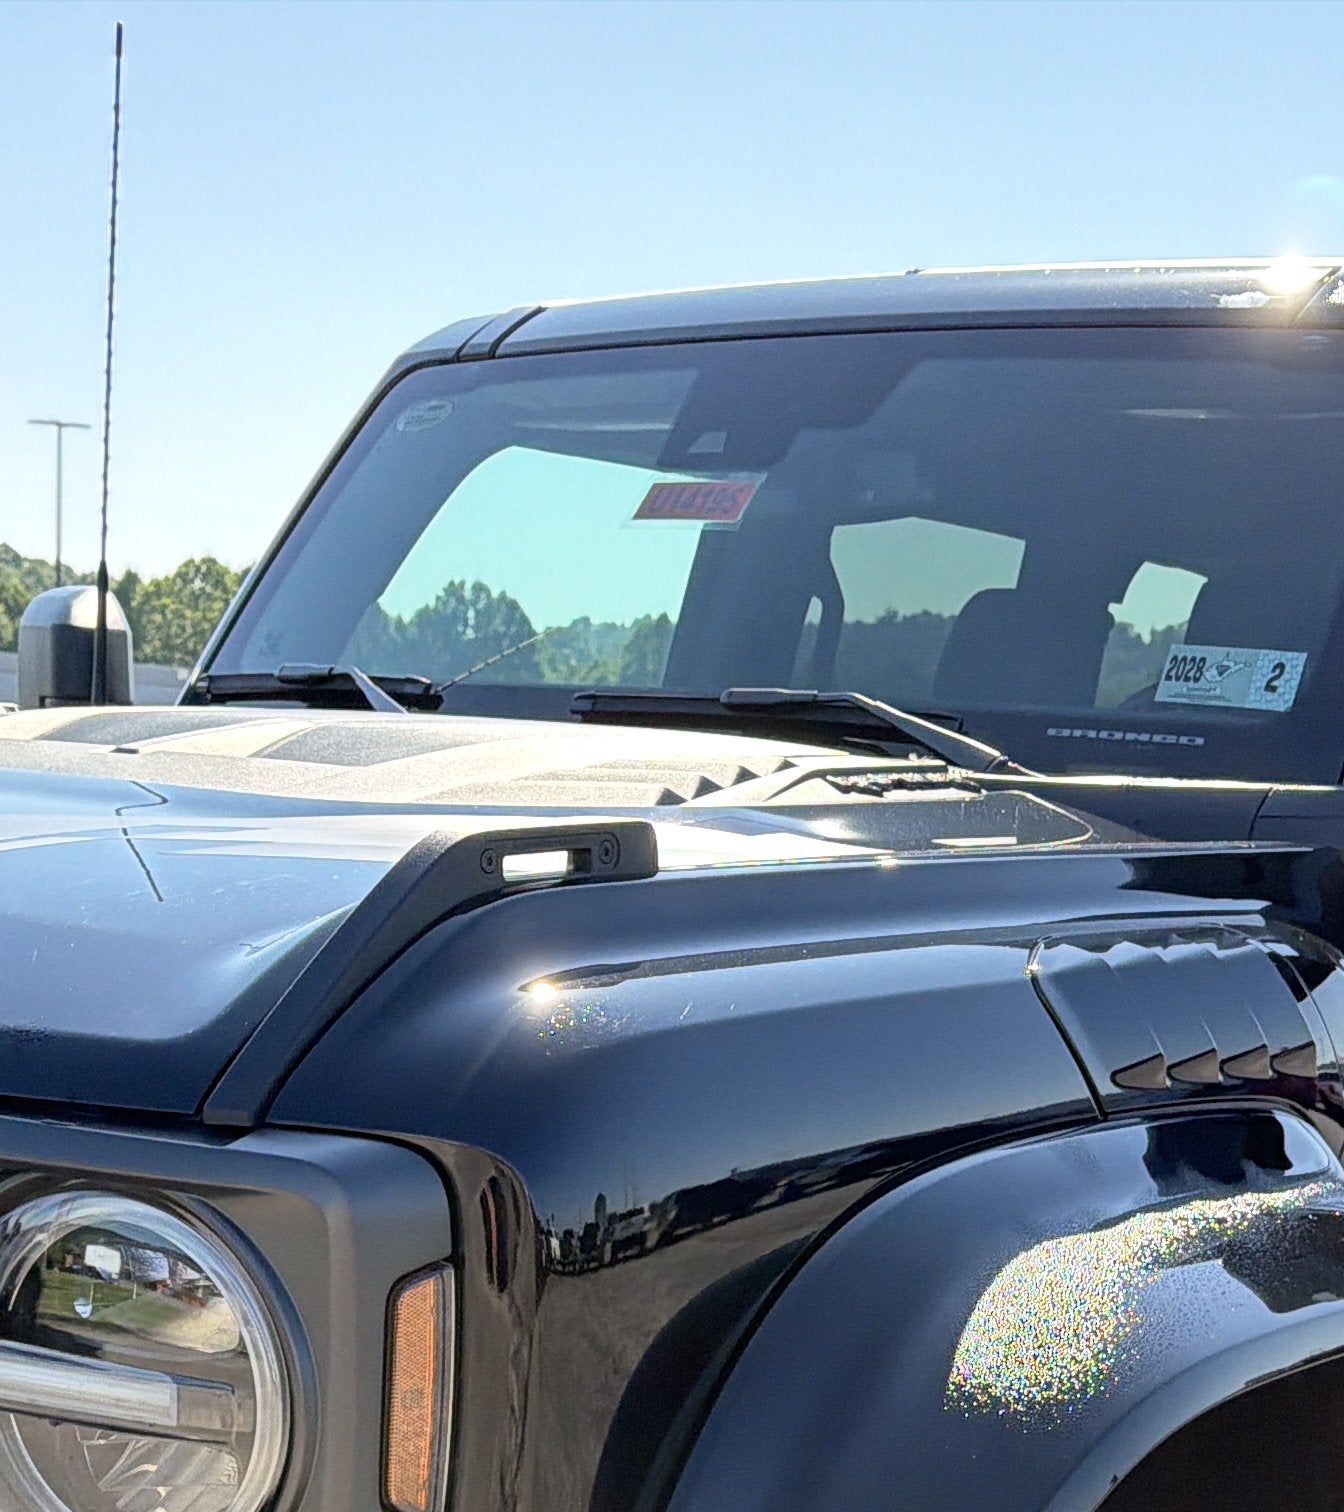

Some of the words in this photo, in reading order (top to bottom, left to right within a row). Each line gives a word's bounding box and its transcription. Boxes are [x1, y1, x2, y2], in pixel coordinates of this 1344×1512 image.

[1164, 655, 1207, 684] 2028
[1263, 662, 1286, 693] 2
[1046, 728, 1205, 745] BRONCO
